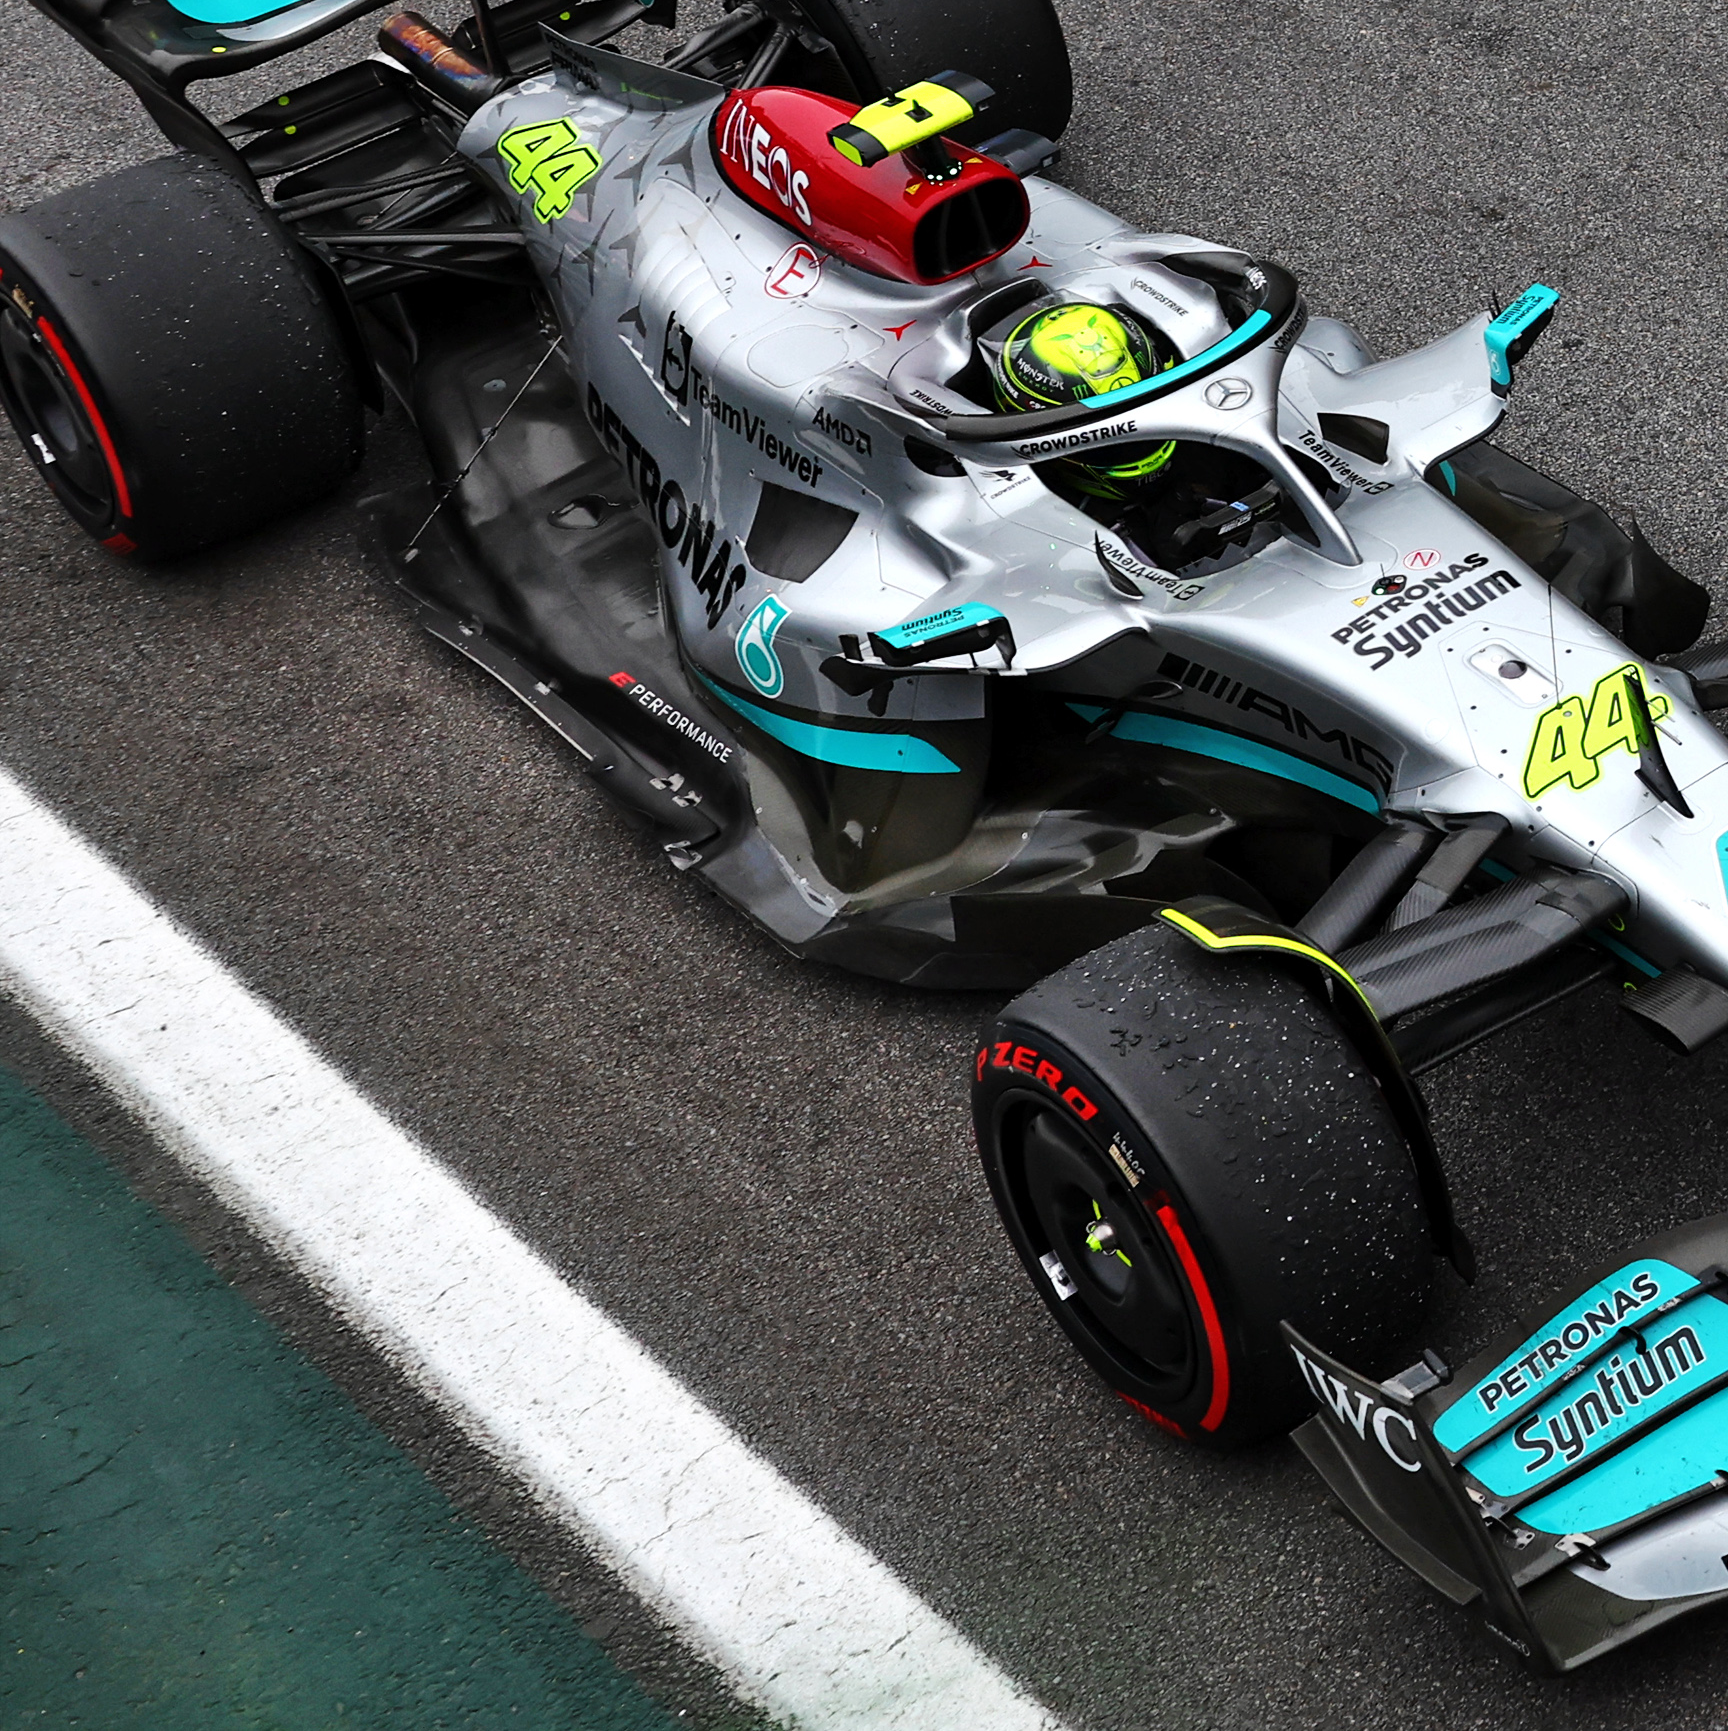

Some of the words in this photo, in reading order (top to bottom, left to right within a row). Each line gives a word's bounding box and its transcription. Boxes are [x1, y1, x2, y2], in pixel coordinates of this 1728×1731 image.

[498, 116, 604, 224] 44
[718, 98, 813, 228] INEOS
[690, 365, 823, 488] TeamViewer
[1020, 420, 1138, 457] CROWDSTRIKE
[1297, 428, 1375, 493] TeamViewer
[587, 381, 747, 630] PETRONAS
[902, 607, 962, 631] Syntium
[904, 615, 965, 638] PETRONAS
[1330, 551, 1490, 647] PETRONAS
[1350, 568, 1522, 671] Syntium
[1244, 691, 1405, 786] AMG
[1524, 664, 1672, 798] 44
[989, 1041, 1100, 1123] ZERO
[1476, 1272, 1661, 1415] PETRONAS
[1290, 1343, 1422, 1473] IWC
[1512, 1323, 1705, 1477] Syntium
